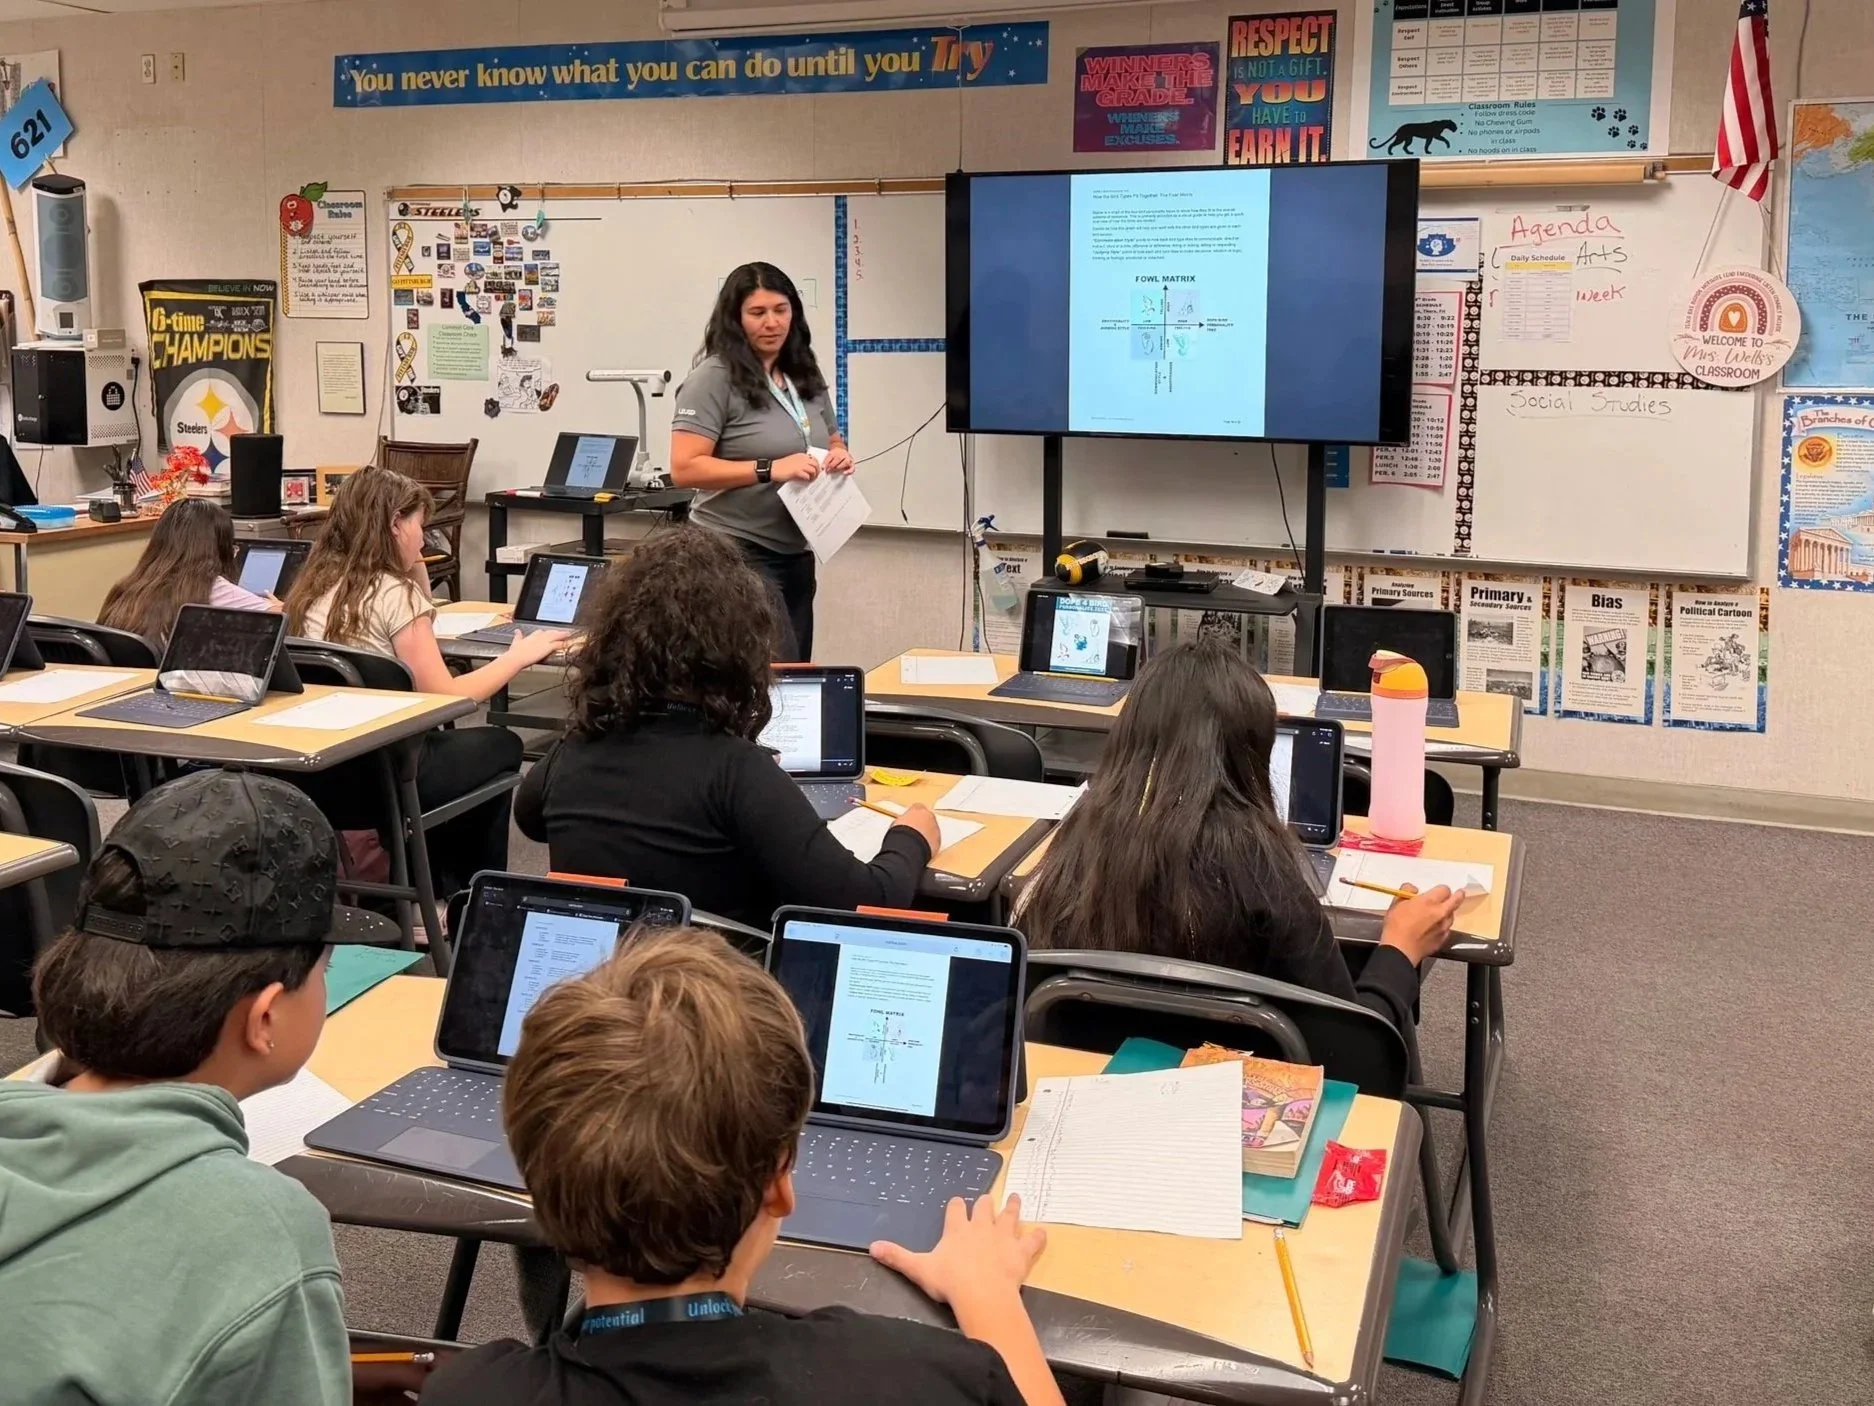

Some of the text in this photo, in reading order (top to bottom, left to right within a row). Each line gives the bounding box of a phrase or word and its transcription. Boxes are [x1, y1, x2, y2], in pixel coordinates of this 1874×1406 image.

[1231, 15, 1334, 58] RESPECT
[350, 35, 995, 93] You never know what you can do until you Try
[1084, 52, 1211, 75] WINNERS
[1233, 66, 1244, 79] IS
[1247, 59, 1275, 78] NOT
[1288, 57, 1328, 77] GIFT.
[1080, 69, 1214, 92] MAKE THE
[1095, 87, 1195, 108] GRADE.
[1232, 79, 1326, 105] YOU
[1468, 101, 1536, 110] Classroom Rules
[1107, 110, 1180, 125] WHINERS
[1251, 107, 1307, 125] HAVE TO
[1485, 119, 1515, 127] Chewing
[10, 108, 52, 160] 621
[1120, 122, 1165, 135] MAKE
[1479, 128, 1504, 136] phones
[1104, 134, 1180, 146] EXCUSES.
[1227, 125, 1328, 166] EARN IT.
[1511, 212, 1621, 246] Agenda
[1511, 255, 1530, 263] Daily
[1576, 241, 1628, 265] Arts
[1162, 275, 1196, 283] MATRIX
[208, 284, 274, 292] BELIEVE IN NOW
[1576, 285, 1626, 301] week
[152, 307, 205, 332] 6-time
[1845, 313, 1868, 321] THE
[1702, 334, 1764, 348] WELCOME TO
[152, 333, 272, 370] CHAMPIONS
[1695, 365, 1760, 380] CLASSROOM
[1510, 389, 1672, 415] Social Studies
[176, 421, 208, 435] Steelers
[1800, 413, 1868, 427] Branches of
[1002, 563, 1021, 574] ext
[1371, 587, 1434, 599] Primary Sources
[1471, 586, 1525, 603] Primary
[1591, 593, 1623, 609] Bias
[1469, 601, 1532, 611] Secondary Sources
[1679, 606, 1753, 618] Political Cartoon
[590, 1307, 645, 1333] potential
